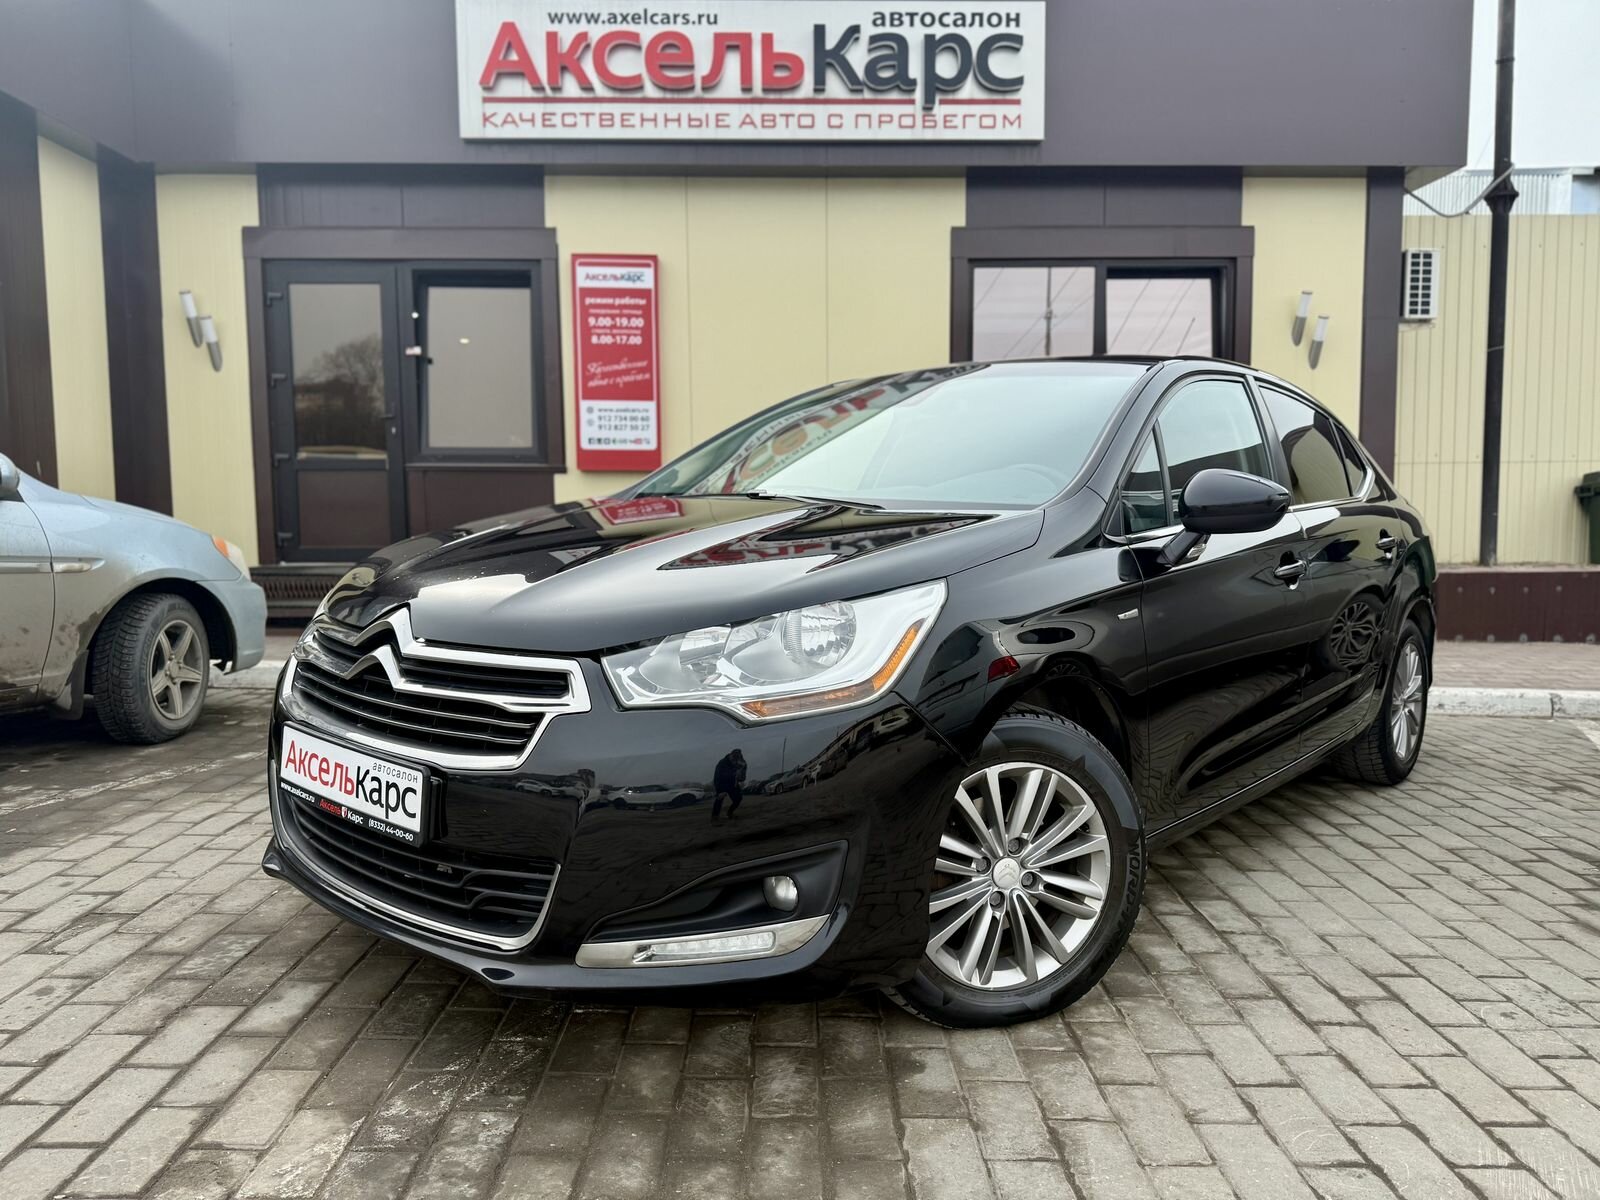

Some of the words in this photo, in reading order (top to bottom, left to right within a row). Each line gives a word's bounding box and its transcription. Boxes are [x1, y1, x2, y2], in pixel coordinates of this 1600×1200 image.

[547, 8, 719, 26] www.axelcars.ru
[871, 10, 1021, 29] автосалон
[482, 112, 730, 129] КАЧЕСТВЕННЫЕ
[739, 113, 815, 130] АВТО
[827, 114, 844, 130] С
[855, 113, 1022, 130] ПРОБЕГОМ
[588, 316, 645, 328] 9.00-19.00
[591, 334, 643, 345] 8.00-17.00
[372, 762, 418, 783] автосалон
[319, 798, 342, 816] Аксель
[347, 810, 364, 825] Карс
[386, 827, 414, 842] 44-00-60
